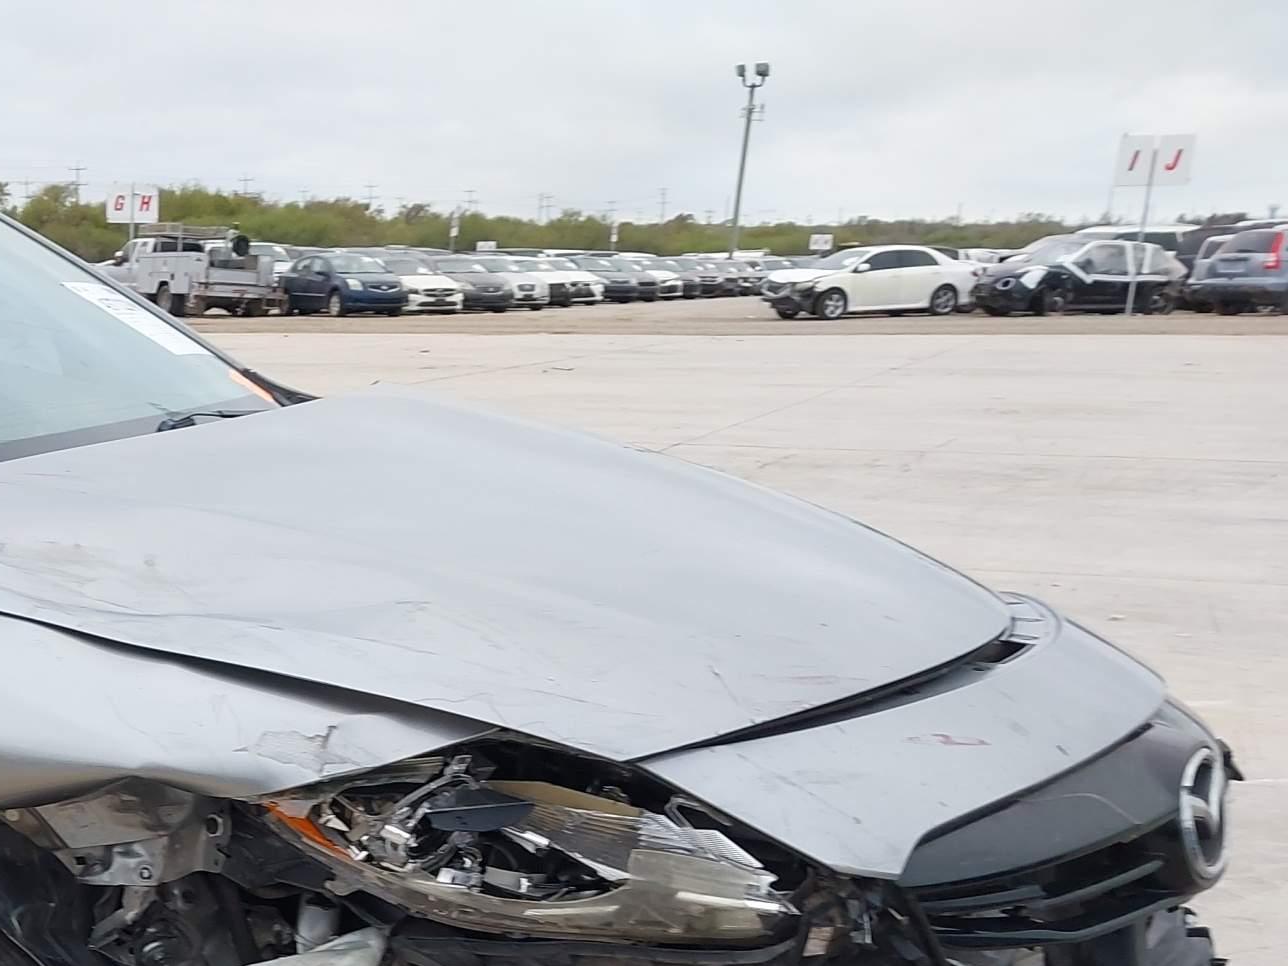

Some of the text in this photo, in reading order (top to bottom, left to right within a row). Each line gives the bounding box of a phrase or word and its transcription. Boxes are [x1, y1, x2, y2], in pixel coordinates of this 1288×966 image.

[1164, 148, 1184, 171] J
[114, 194, 153, 212] G H
